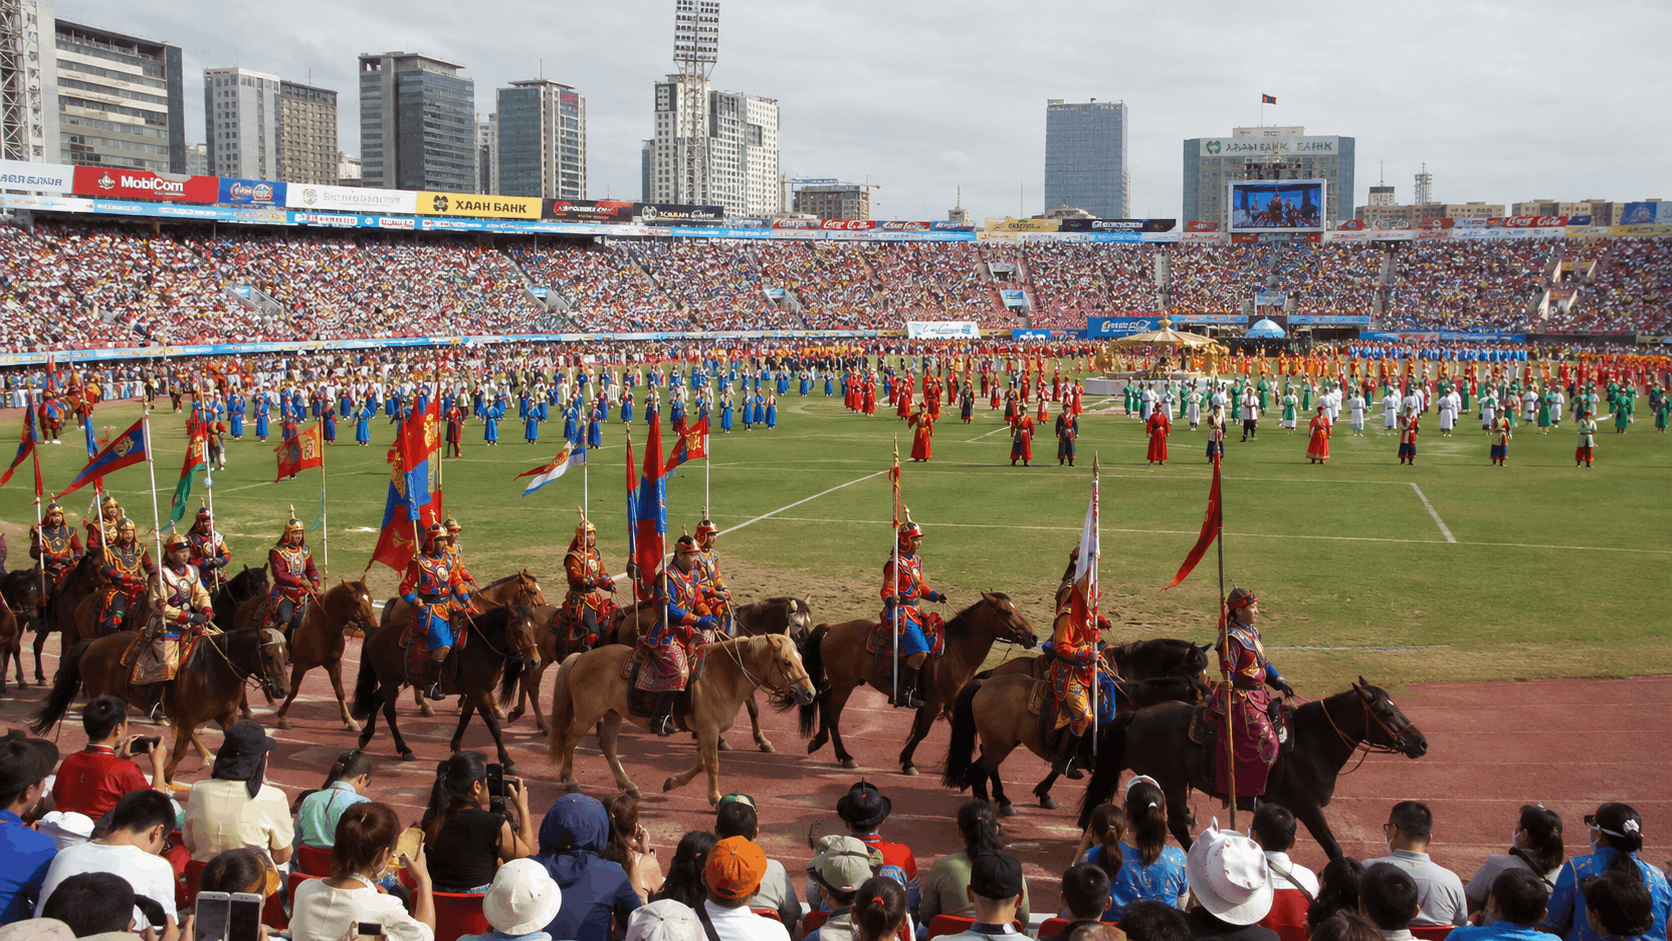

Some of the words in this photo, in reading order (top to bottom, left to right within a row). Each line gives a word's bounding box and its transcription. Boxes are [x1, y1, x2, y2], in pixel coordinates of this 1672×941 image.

[121, 175, 183, 192] MobiCom
[455, 200, 490, 211] ХААН
[493, 203, 527, 213] БАНК
